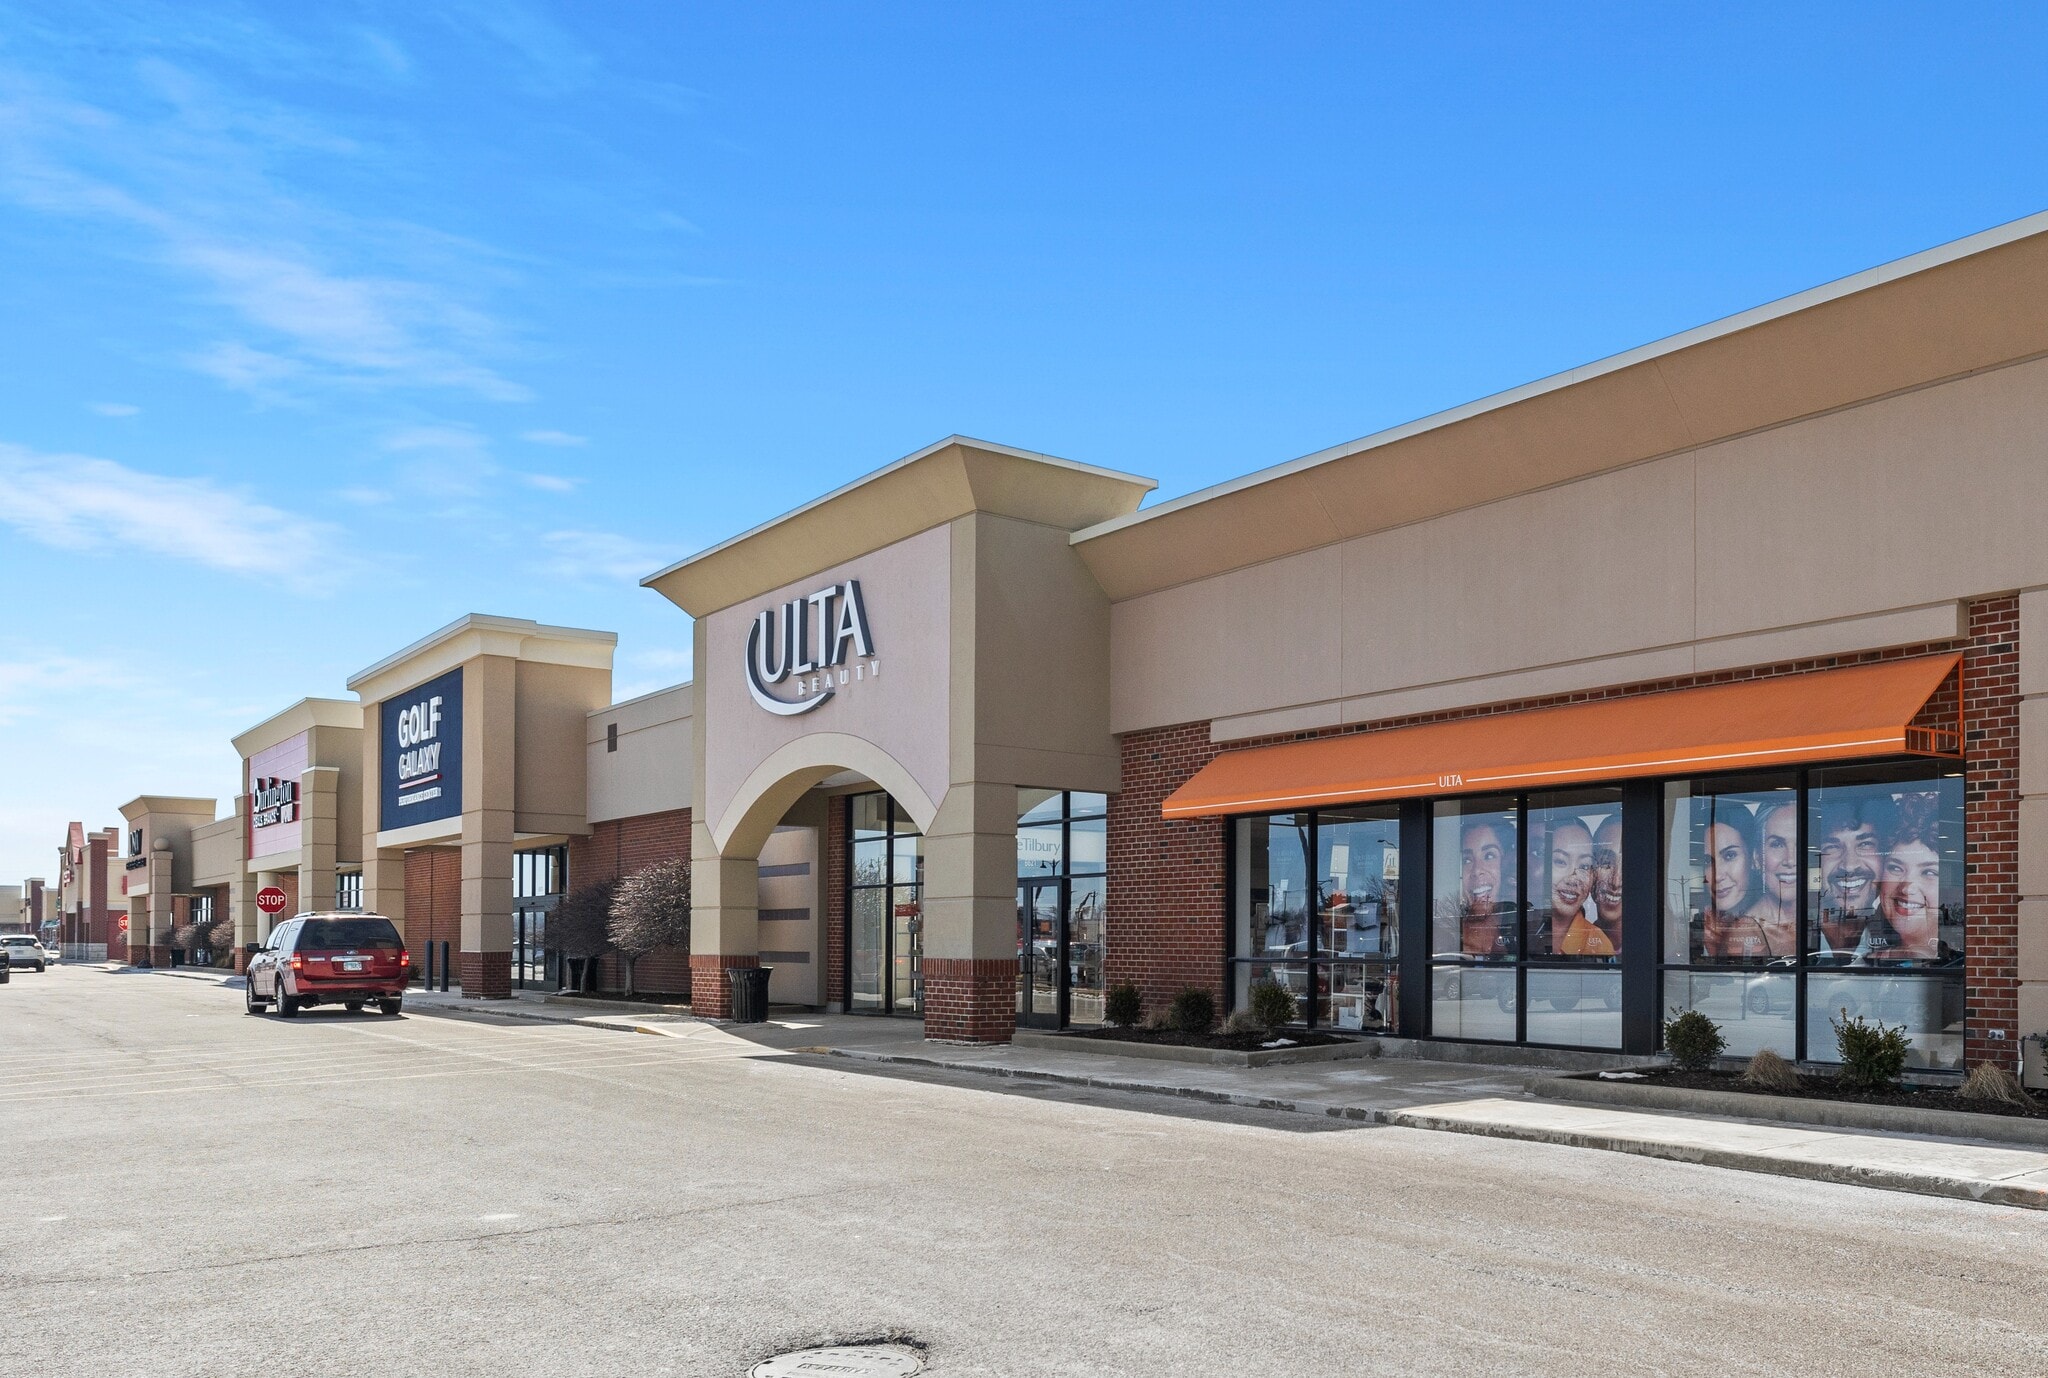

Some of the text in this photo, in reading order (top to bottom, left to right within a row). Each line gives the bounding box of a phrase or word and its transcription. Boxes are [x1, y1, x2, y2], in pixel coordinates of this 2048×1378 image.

[758, 580, 875, 684] ULTA
[798, 660, 880, 696] BEAUTY
[398, 696, 442, 748] GOLF
[398, 742, 441, 780] GALAXY
[1439, 774, 1463, 788] ULTA
[258, 894, 285, 906] STOP
[1869, 937, 1888, 947] ULTA
